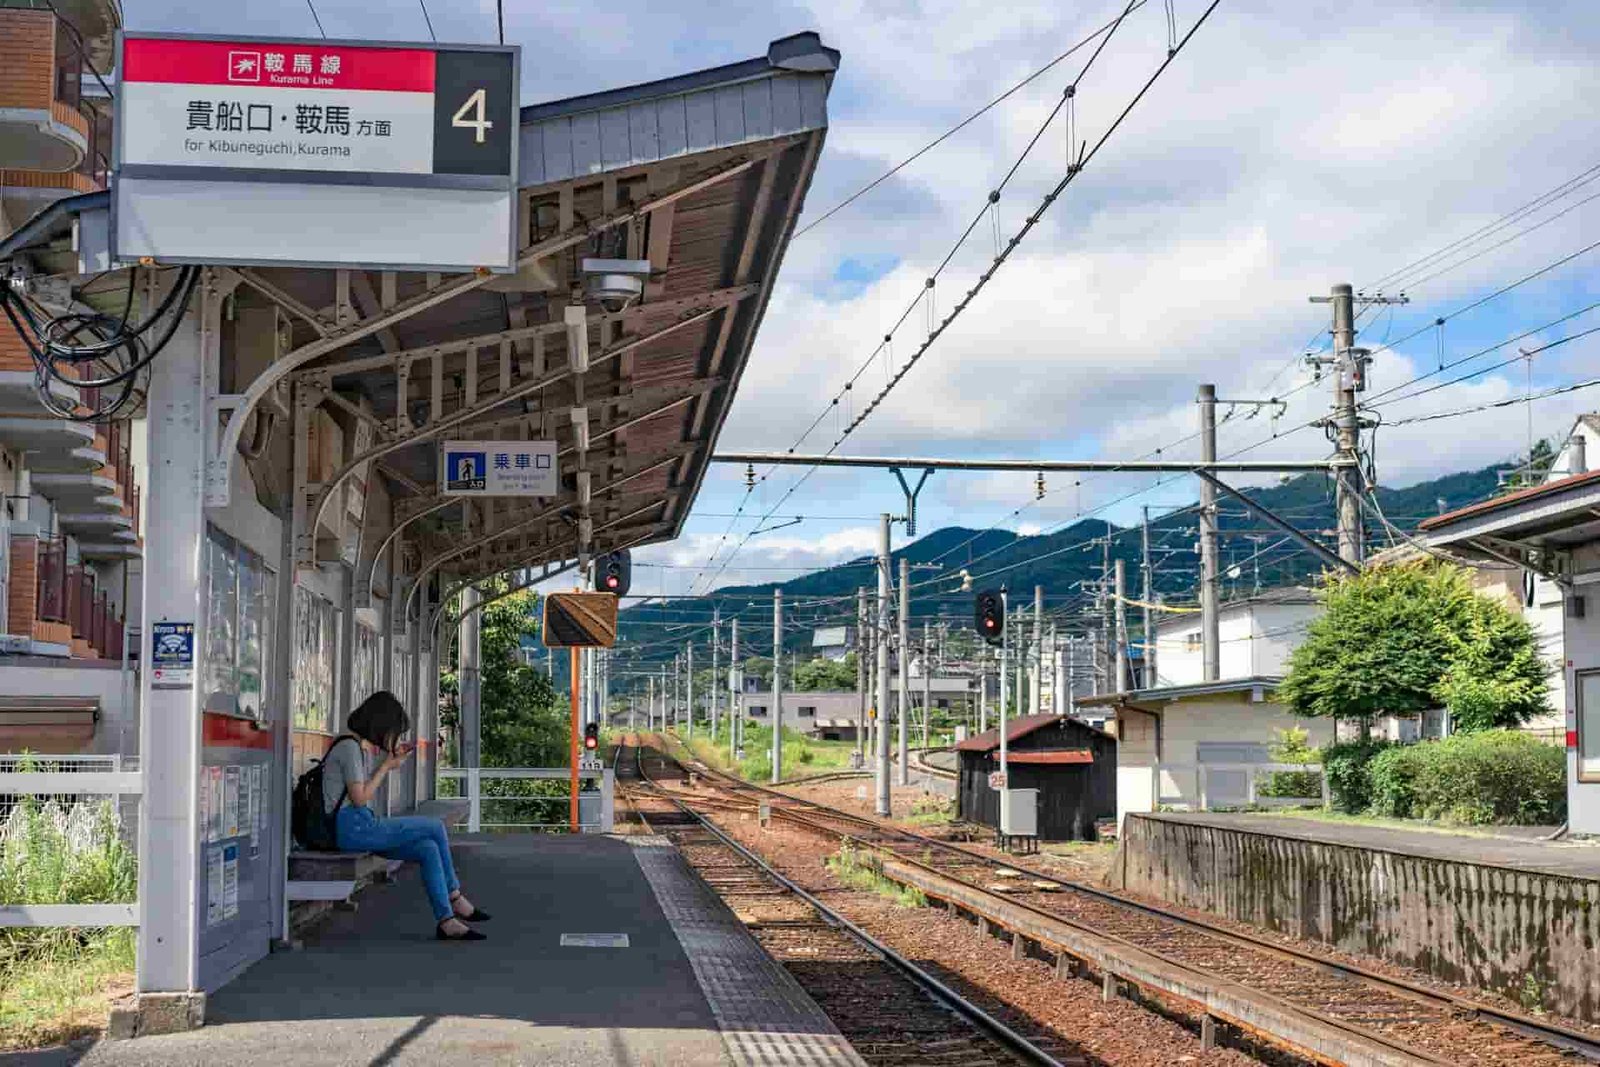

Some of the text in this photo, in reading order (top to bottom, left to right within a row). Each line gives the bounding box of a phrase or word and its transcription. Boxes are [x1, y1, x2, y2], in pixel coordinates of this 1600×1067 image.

[264, 53, 341, 74] 鞍馬線
[270, 74, 334, 85] Kurama Line
[452, 88, 493, 143] 4
[184, 138, 202, 151] for
[493, 453, 551, 470] 乗車口
[991, 774, 1005, 787] 25
